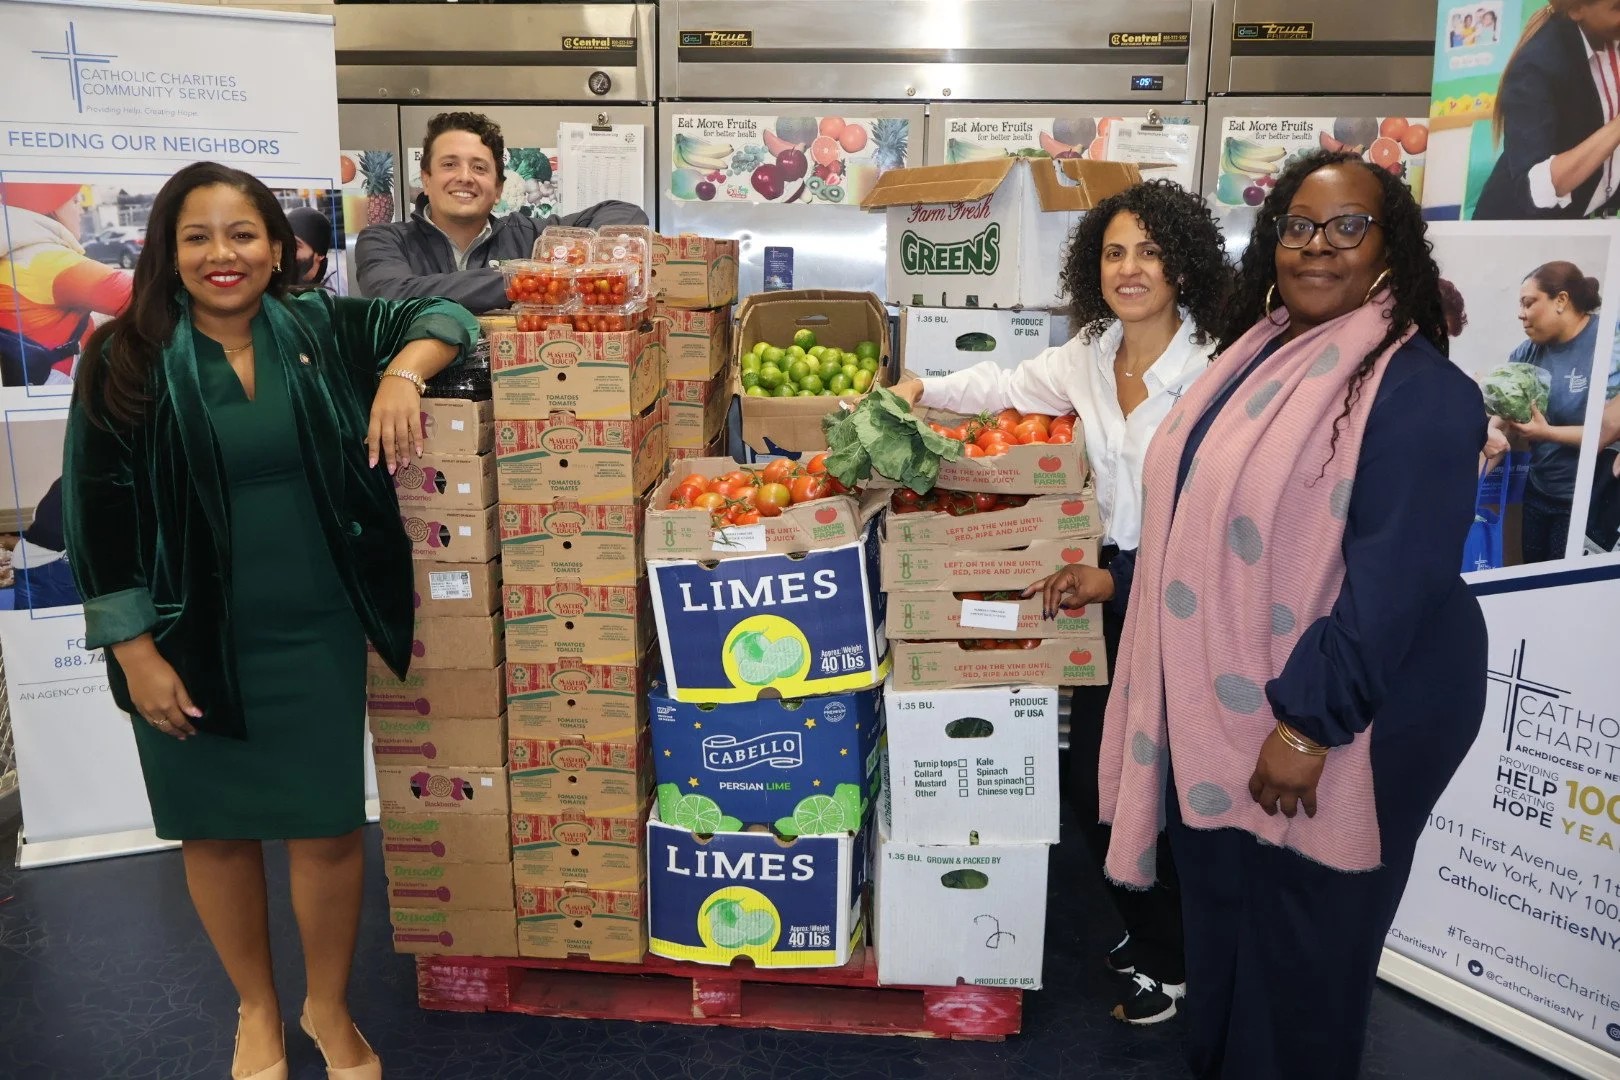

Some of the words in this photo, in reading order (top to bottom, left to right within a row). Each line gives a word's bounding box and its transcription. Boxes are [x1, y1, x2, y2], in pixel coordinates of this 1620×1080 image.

[1262, 24, 1308, 33] true
[573, 38, 610, 46] Central
[705, 32, 748, 40] true
[1122, 33, 1161, 42] Central
[81, 68, 156, 83] CATHOLIC
[161, 73, 236, 88] CHARITIES
[83, 83, 173, 98] COMMUNITY
[179, 87, 248, 102] SERVICES
[86, 105, 121, 115] Providing
[144, 108, 175, 118] Creating
[678, 118, 693, 128] Eat
[697, 118, 723, 129] More
[727, 119, 757, 129] Fruits
[951, 121, 967, 132] Eat
[971, 121, 998, 132] More
[1002, 121, 1033, 132] Fruits
[1229, 120, 1245, 131] Eat
[1249, 120, 1278, 132] More
[1281, 120, 1313, 132] Fruits
[716, 130, 735, 138] better
[738, 130, 757, 138] health
[978, 133, 988, 141] for
[990, 133, 1010, 141] better
[1013, 132, 1033, 141] health
[1255, 132, 1266, 140] for
[1268, 132, 1289, 140] better
[1292, 132, 1313, 140] health
[8, 131, 104, 149] FEEDING
[112, 135, 156, 151] OUR
[163, 138, 280, 155] NEIGHBORS
[907, 202, 946, 223] Farm
[948, 194, 993, 221] Fresh
[900, 222, 1000, 275] GREENS
[934, 316, 948, 324] BU.
[1011, 318, 1043, 327] PRODUCE
[1014, 328, 1024, 336] OF
[1025, 328, 1039, 337] USA
[946, 527, 964, 536] LEFT
[980, 522, 997, 531] THE
[999, 520, 1018, 529] VINE
[1020, 517, 1044, 526] UNTIL
[955, 533, 973, 542] RED,
[975, 531, 994, 539] RIPE
[995, 528, 1014, 536] AND
[1015, 526, 1038, 535] JUICY
[999, 560, 1017, 568] VINE
[1013, 567, 1036, 575] JUICY
[679, 569, 838, 612] LIMES
[54, 654, 105, 668] 888.74
[821, 658, 838, 672] 40
[842, 653, 865, 670] lbs
[20, 691, 35, 700] AN
[38, 687, 79, 699] AGENCY
[83, 685, 96, 694] OF
[897, 702, 916, 710] 1.35
[1009, 698, 1048, 706] PRODUCE
[1014, 710, 1025, 718] OF
[1026, 709, 1044, 718] USA
[1520, 695, 1620, 738] CATHO
[708, 740, 796, 765] CABELLO
[914, 760, 939, 769] Turnip
[940, 759, 958, 770] tops
[976, 758, 994, 766] Kale
[1515, 744, 1584, 772] ARCHDIOCESE
[1587, 766, 1602, 776] OF
[1604, 771, 1620, 783] NE
[914, 770, 943, 778] Collard
[976, 768, 1008, 776] Spinach
[1499, 755, 1559, 782] PROVIDING
[719, 781, 764, 791] PERSIAN
[766, 782, 791, 791] LIME
[977, 778, 992, 786] Bun
[994, 777, 1025, 786] spinach
[1496, 765, 1558, 797] HELP
[977, 788, 1008, 796] Chinese
[1495, 784, 1555, 812] CREATING
[1492, 794, 1553, 829] HOPE
[1561, 818, 1620, 851] YEA
[1429, 812, 1464, 837] 1011
[1471, 828, 1506, 853] First
[1511, 845, 1583, 886] Avenue,
[666, 845, 815, 882] LIMES
[888, 852, 905, 860] 1.35
[907, 854, 922, 862] BU.
[927, 856, 954, 864] GROWN
[1459, 846, 1497, 872] New
[1503, 862, 1542, 893] York,
[1549, 882, 1578, 903] NY
[1585, 896, 1620, 923] 100
[789, 932, 805, 947] 40
[809, 932, 830, 947] lbs
[1447, 925, 1620, 1012] #TeamCatholicCharitie
[1486, 970, 1584, 1021] @CathCharitiesNY
